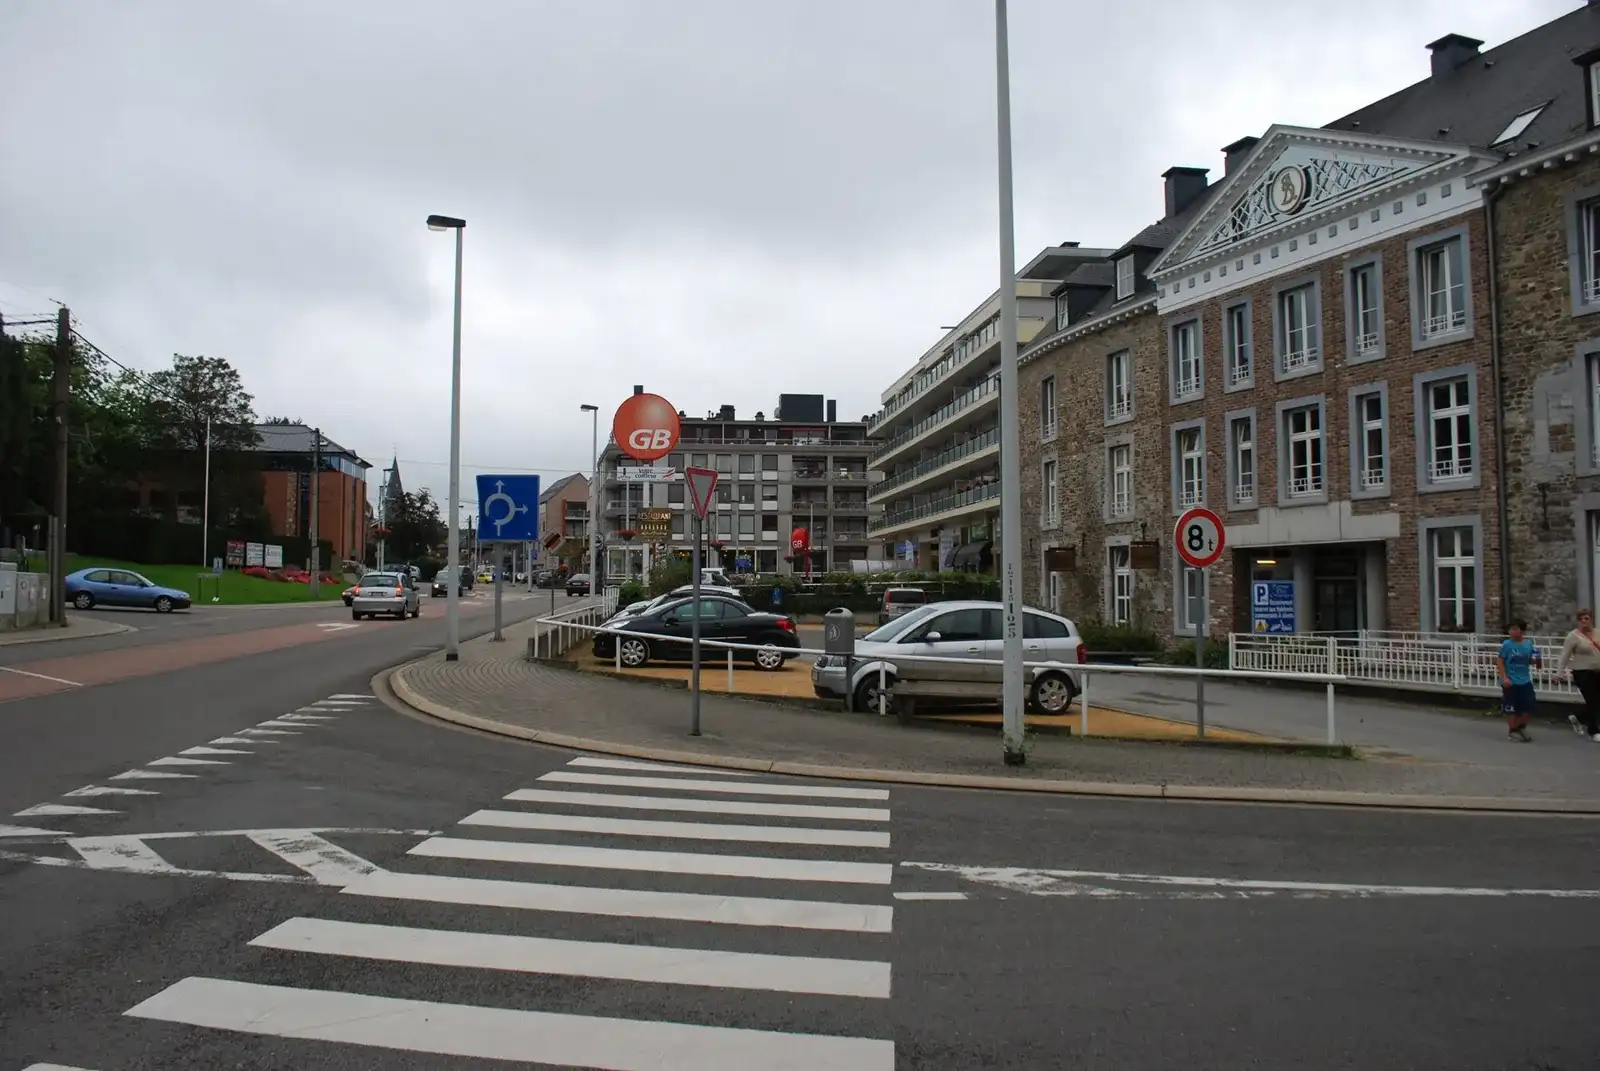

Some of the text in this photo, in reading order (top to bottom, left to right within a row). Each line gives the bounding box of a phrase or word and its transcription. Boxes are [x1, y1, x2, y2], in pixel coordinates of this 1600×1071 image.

[628, 428, 672, 450] GB
[792, 540, 803, 549] GB
[1187, 524, 1214, 552] 8 t
[1256, 585, 1266, 603] P
